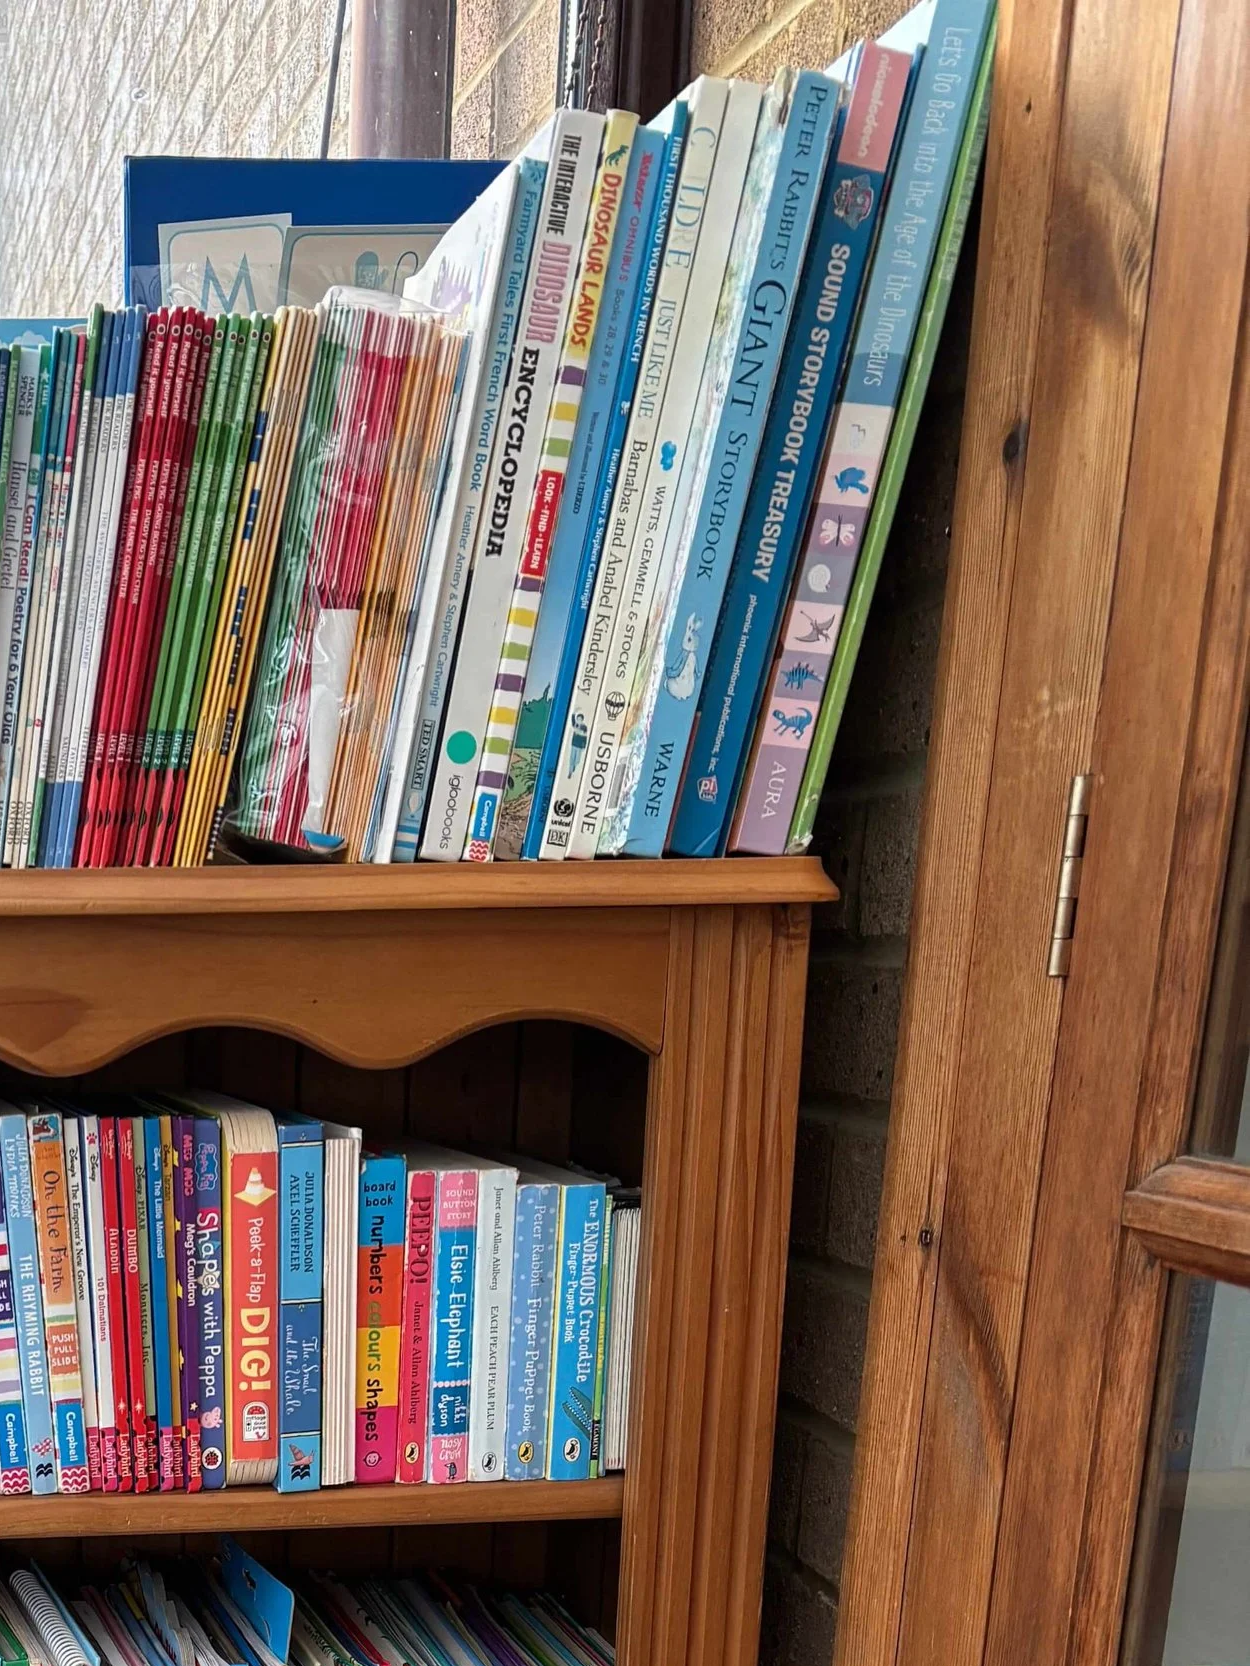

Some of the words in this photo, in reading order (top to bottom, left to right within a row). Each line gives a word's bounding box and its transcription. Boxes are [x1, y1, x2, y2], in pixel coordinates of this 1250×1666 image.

[938, 27, 973, 68] Let's
[792, 84, 829, 159] PETER
[857, 53, 891, 160] nickelodeon
[920, 100, 955, 136] Back
[934, 72, 962, 99] Go
[562, 134, 582, 154] THE
[912, 140, 938, 174] into
[546, 154, 578, 236] INTERACTIVE
[593, 172, 622, 276] DINOSAUR
[769, 168, 810, 272] RABBIT'S
[891, 211, 928, 249] Age
[909, 180, 927, 209] the
[525, 240, 572, 345] DINOSAUR
[815, 243, 851, 324] SOUND
[881, 275, 907, 303] the
[890, 247, 917, 270] of
[569, 277, 600, 349] LANDS
[734, 278, 787, 416] GIANT
[863, 305, 907, 387] Dinosaurs
[778, 326, 832, 462] STORYBOOK
[484, 347, 540, 560] ENCYCLOPEDIA
[613, 439, 649, 512] Barnabas
[24, 501, 36, 534] Can
[610, 515, 627, 549] and
[697, 429, 750, 581] STORYBOOK
[750, 467, 795, 584] TREASURY
[18, 540, 33, 584] Read!
[597, 551, 622, 609] Anabel
[11, 586, 28, 636] Poetry
[10, 638, 21, 657] for
[576, 612, 612, 697] Kindersley
[4, 674, 18, 710] Year
[439, 774, 463, 850] igloobooks
[580, 730, 615, 836] USBORNE
[644, 740, 675, 818] WARNE
[760, 759, 787, 821] AURA
[364, 1180, 396, 1193] board
[365, 1195, 394, 1207] book
[18, 1254, 33, 1280] THE
[196, 1211, 218, 1296] Shapes
[249, 1216, 267, 1304] Peek-a-Flap
[370, 1215, 385, 1296] numbers
[410, 1195, 431, 1285] PEEPO!
[579, 1221, 600, 1305] ENORMOUS
[22, 1282, 41, 1341] RHYMING
[203, 1300, 220, 1343] with
[366, 1300, 381, 1372] colours
[575, 1307, 595, 1384] Crocodile
[28, 1343, 45, 1398] RABBIT
[199, 1345, 222, 1399] Peppa
[240, 1306, 271, 1392] DIG!
[358, 1377, 385, 1442] shapes
